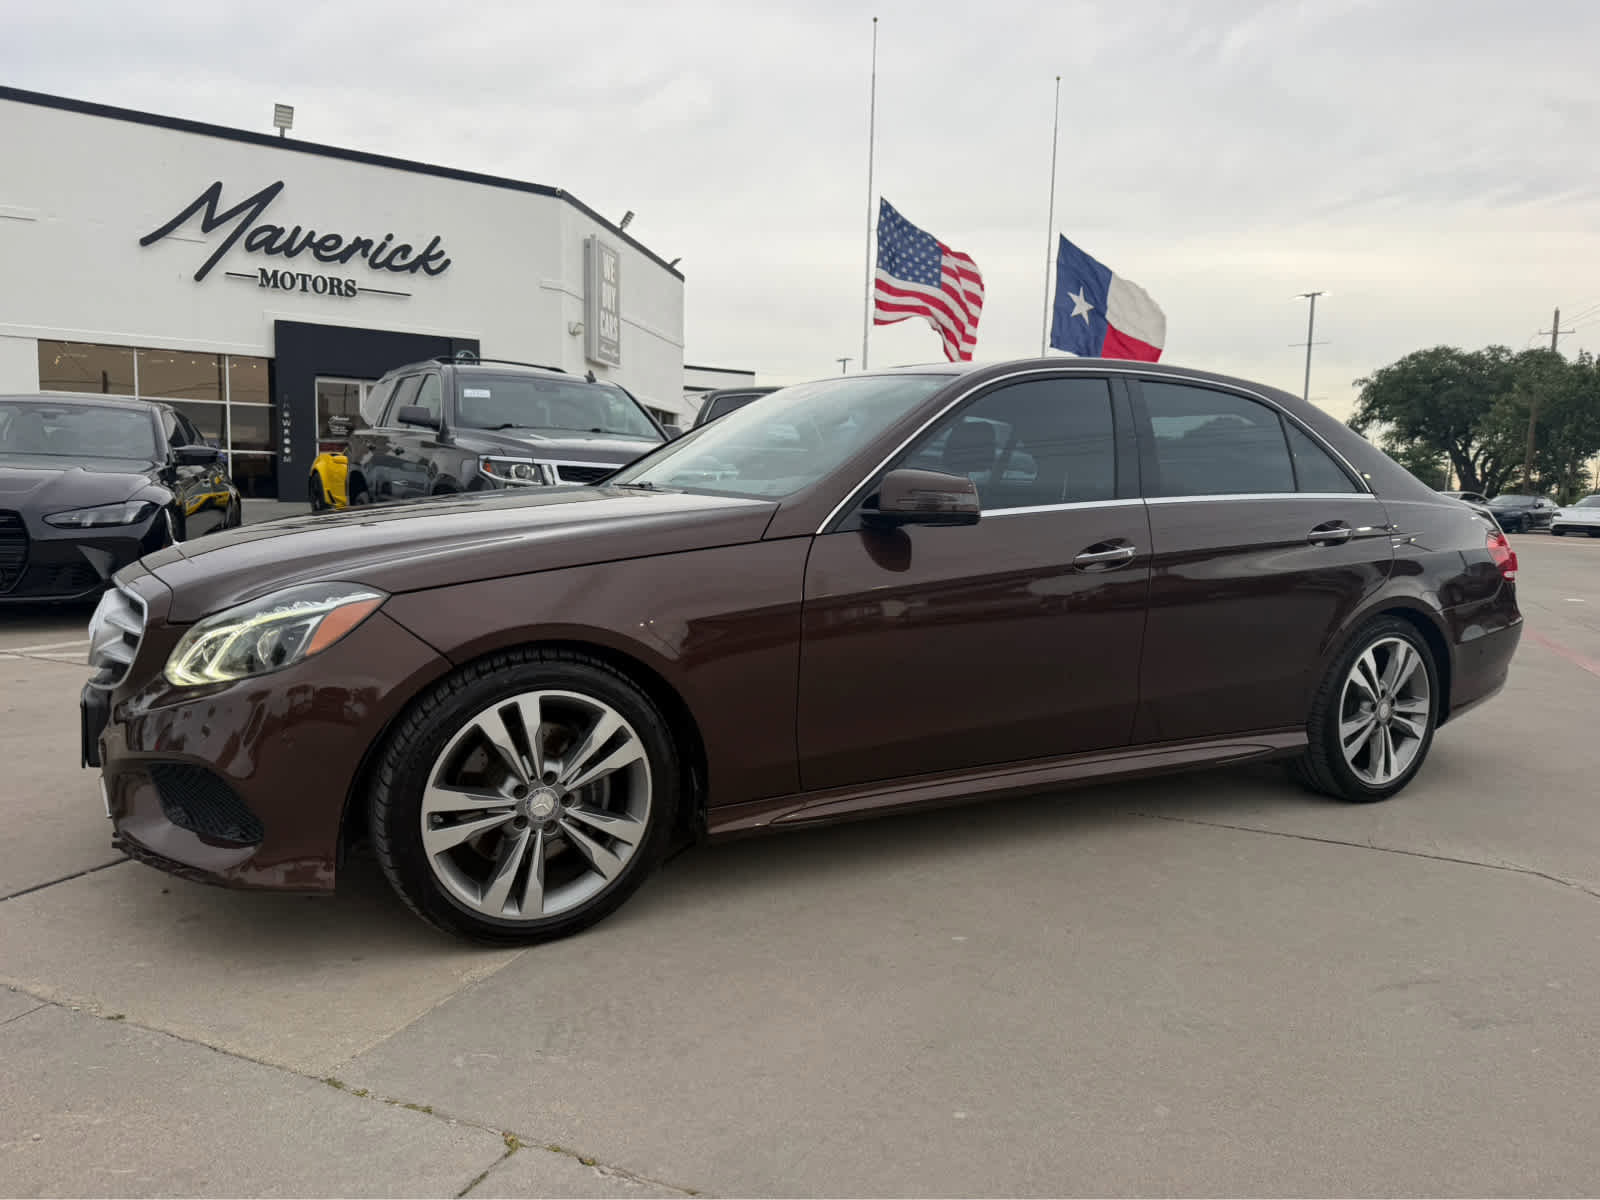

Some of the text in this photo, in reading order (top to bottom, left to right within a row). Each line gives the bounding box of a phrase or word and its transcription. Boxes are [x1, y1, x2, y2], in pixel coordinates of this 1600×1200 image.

[139, 180, 452, 282] Maverick
[257, 267, 358, 298] MOTORS
[602, 251, 615, 283] WE
[599, 309, 618, 343] CARS
[282, 394, 292, 463] HOWROOM
